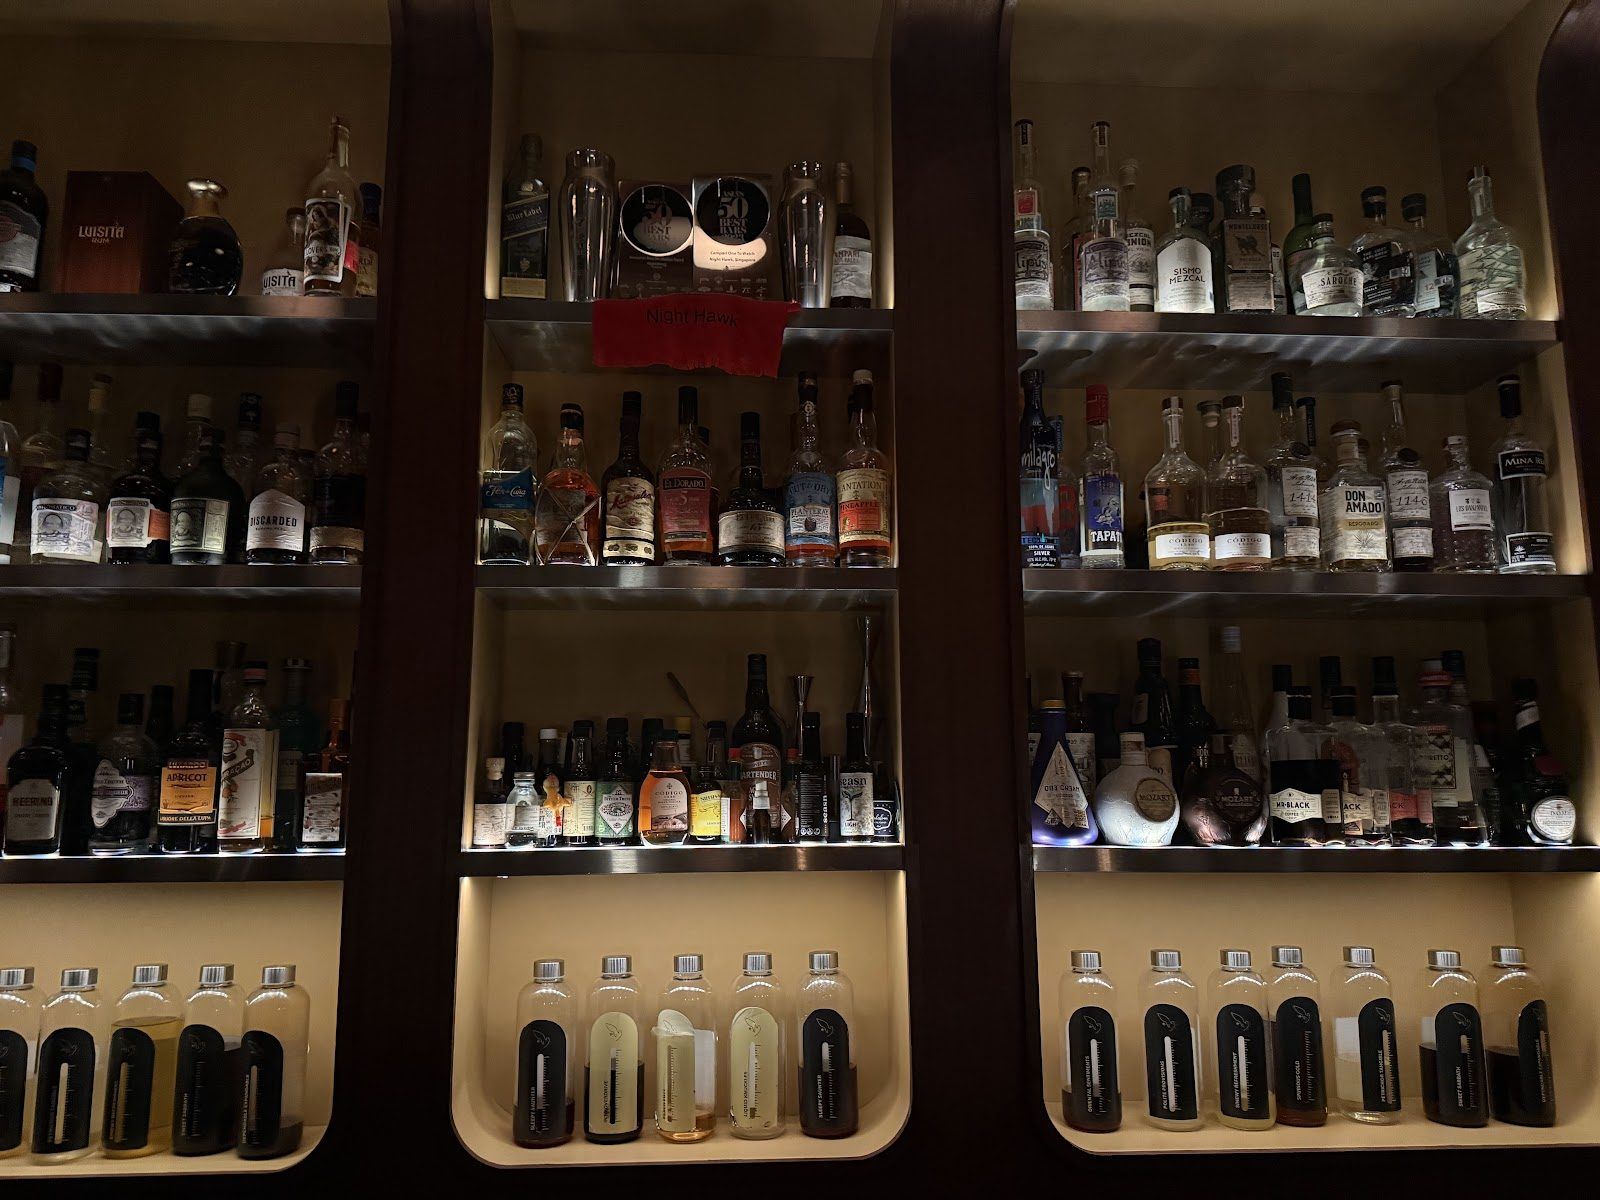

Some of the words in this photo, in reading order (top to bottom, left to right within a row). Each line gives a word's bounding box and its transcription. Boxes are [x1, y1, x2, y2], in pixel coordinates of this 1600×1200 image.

[506, 209, 524, 222] Blue
[523, 206, 543, 218] Label
[718, 197, 749, 219] 50
[719, 218, 748, 227] BEST
[719, 226, 747, 235] BARS
[1173, 267, 1202, 276] SISMO
[1169, 275, 1206, 285] MEZCAL
[647, 307, 690, 324] Night
[694, 307, 737, 327] Hawk
[1021, 438, 1056, 490] milagro
[1504, 457, 1534, 467] MINA
[841, 480, 882, 492] ANTATION
[680, 490, 689, 506] 5
[1345, 490, 1366, 502] DON
[1345, 501, 1382, 513] AMADO
[166, 773, 208, 782] APRICOT
[741, 770, 778, 780] ARTENDER
[1084, 1055, 1092, 1088] SENTIMENTS
[1159, 1060, 1167, 1091] PROVISIONS
[1455, 1066, 1463, 1089] SABBATH
[1161, 1091, 1169, 1110] POLITE
[1456, 1089, 1464, 1107] SWEET
[816, 1099, 824, 1119] SLEEPY
